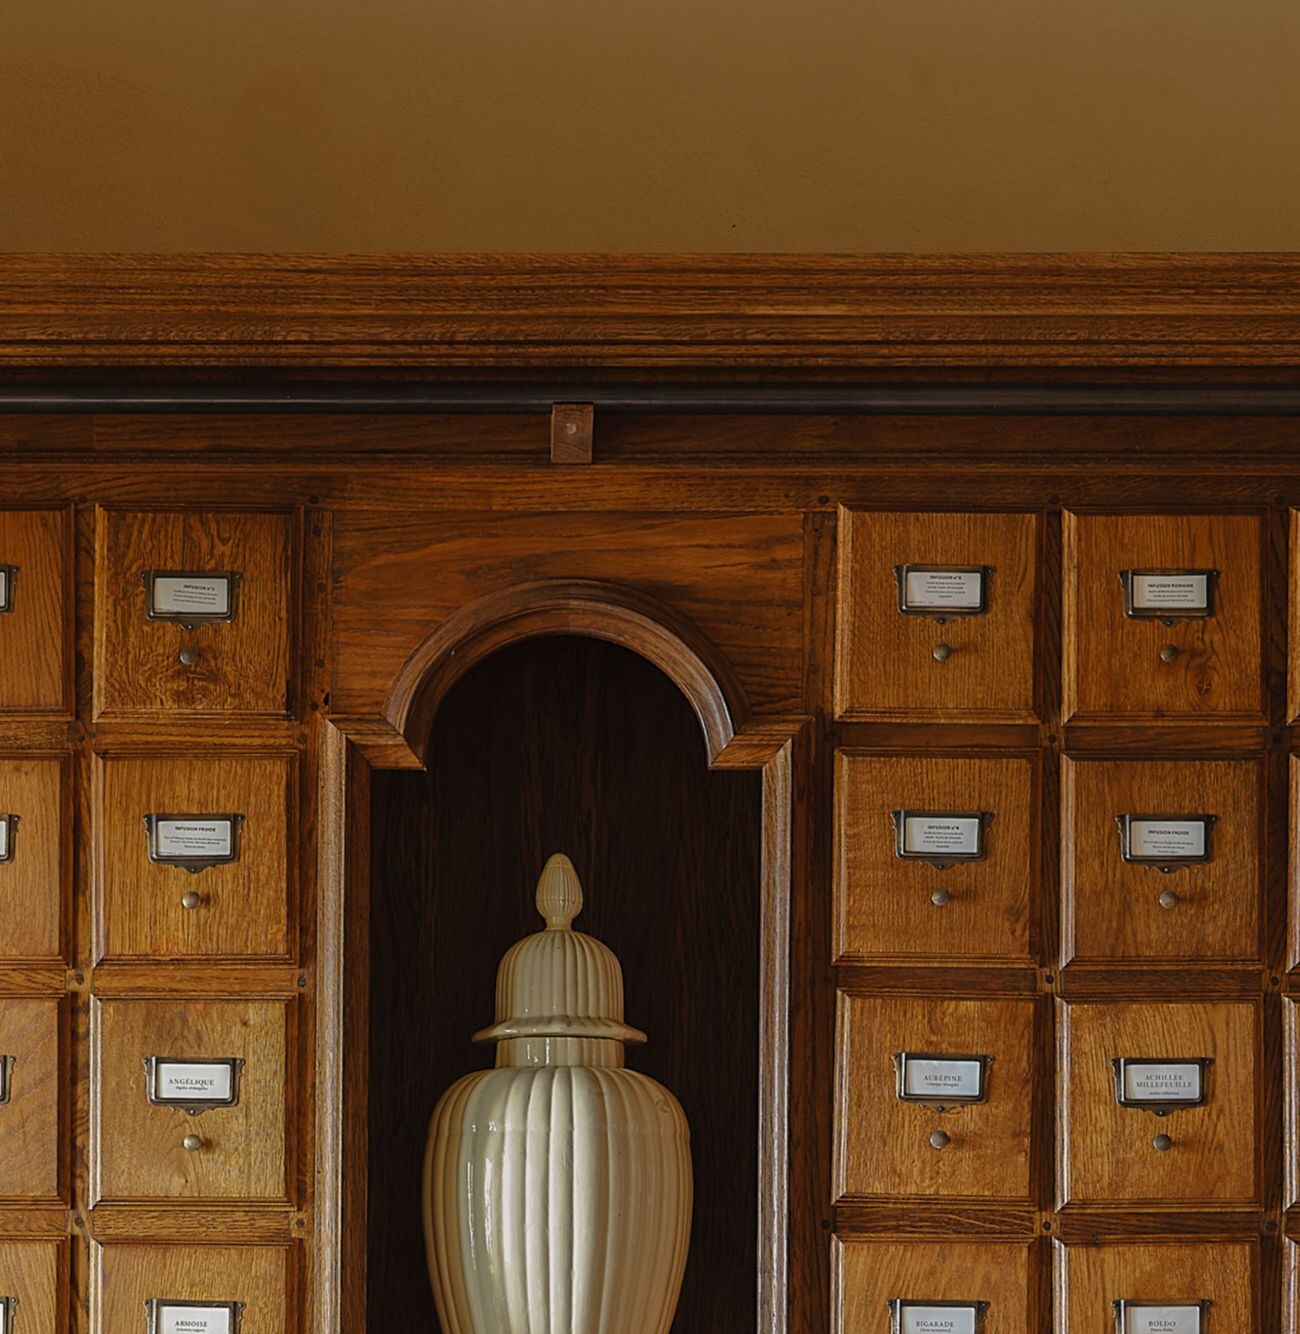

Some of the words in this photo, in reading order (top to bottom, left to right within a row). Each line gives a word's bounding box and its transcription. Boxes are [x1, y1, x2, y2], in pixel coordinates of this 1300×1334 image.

[923, 1074, 963, 1082] AUBÉPINE
[1145, 1073, 1183, 1081] ACHILLÉE
[168, 1078, 215, 1086] ANGÉLIQUE
[915, 1320, 954, 1328] BIGARADE
[1148, 1320, 1176, 1328] BOLDO
